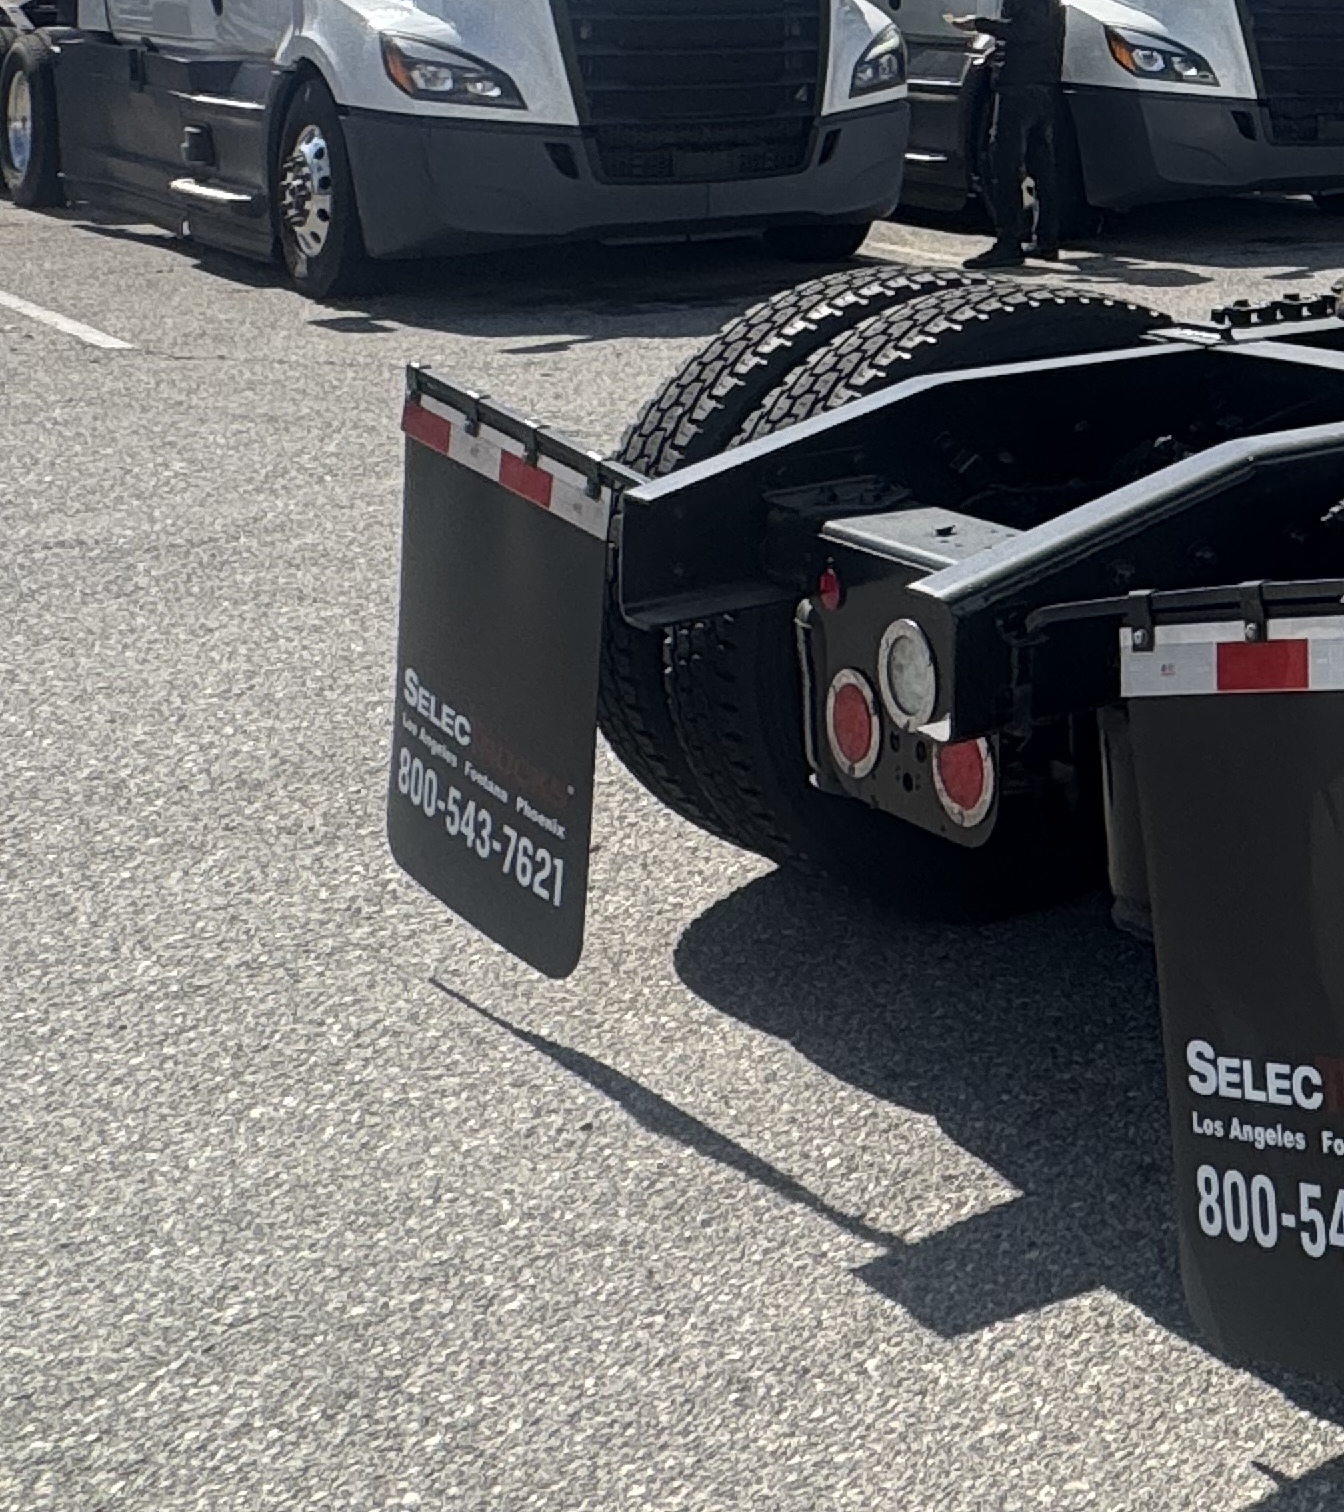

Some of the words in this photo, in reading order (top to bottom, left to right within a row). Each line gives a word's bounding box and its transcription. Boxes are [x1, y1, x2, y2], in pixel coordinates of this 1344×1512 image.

[398, 746, 564, 907] 800-543-7621
[517, 796, 566, 839] Phoenix
[1192, 1110, 1225, 1138] Los
[1229, 1117, 1307, 1150] Angeles
